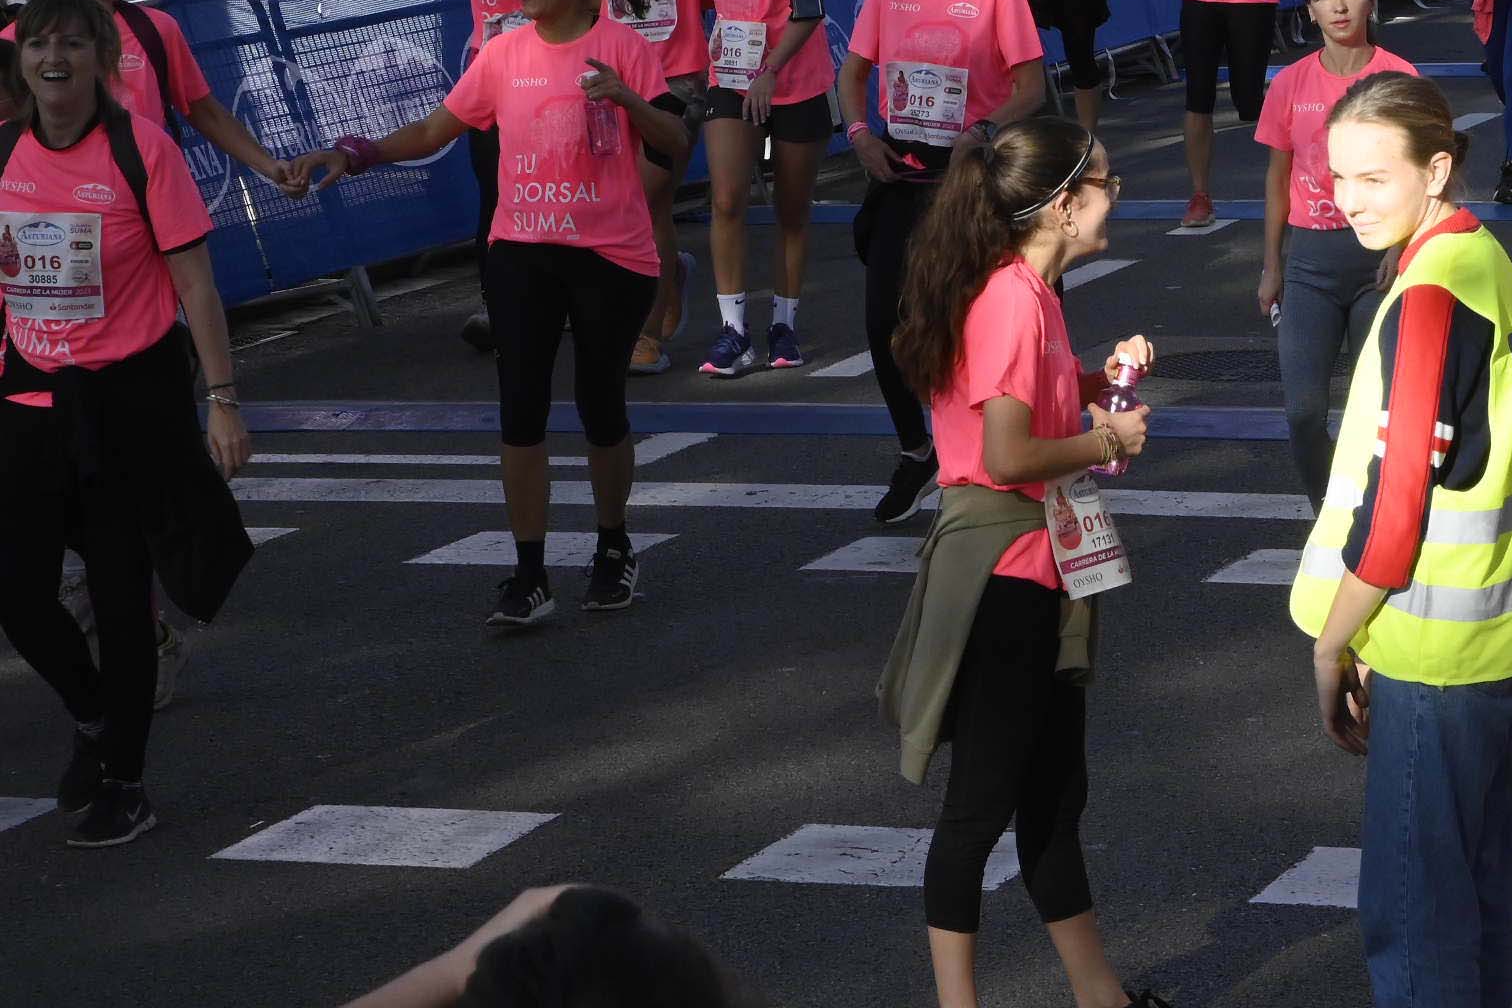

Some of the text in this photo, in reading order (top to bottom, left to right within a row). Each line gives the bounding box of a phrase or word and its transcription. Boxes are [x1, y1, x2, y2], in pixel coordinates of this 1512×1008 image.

[722, 46, 742, 58] 016
[511, 76, 548, 89] OYSHO
[909, 94, 935, 108] 016
[515, 154, 537, 175] TU
[512, 211, 577, 233] SUMA
[23, 255, 62, 270] 016
[28, 274, 58, 285] 30885
[1082, 510, 1111, 532] 016
[1070, 550, 1115, 569] CARRERA DE LA
[1072, 571, 1104, 589] OYSHO
